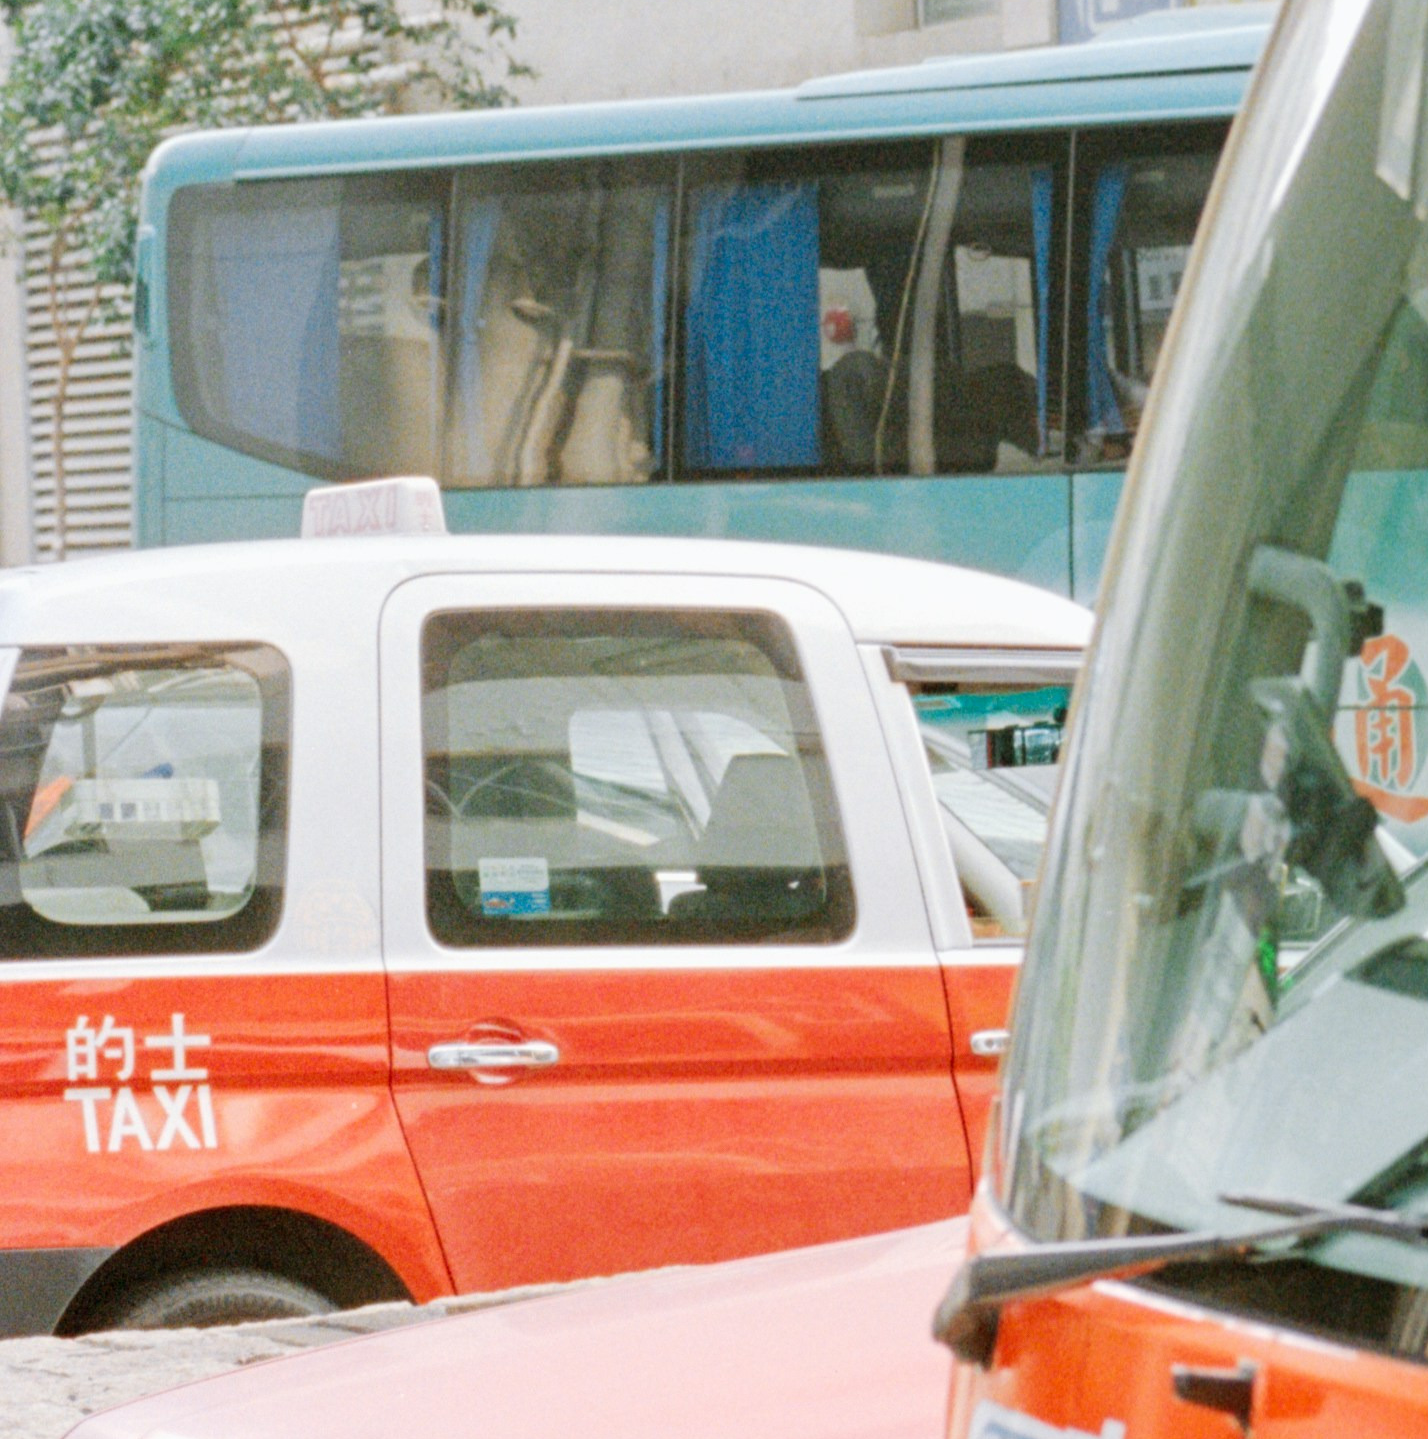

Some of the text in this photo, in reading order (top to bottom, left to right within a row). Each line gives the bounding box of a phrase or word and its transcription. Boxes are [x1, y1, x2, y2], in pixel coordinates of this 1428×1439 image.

[308, 484, 398, 537] TAXI
[65, 1013, 211, 1082] 的士
[64, 1085, 218, 1153] TAXI
